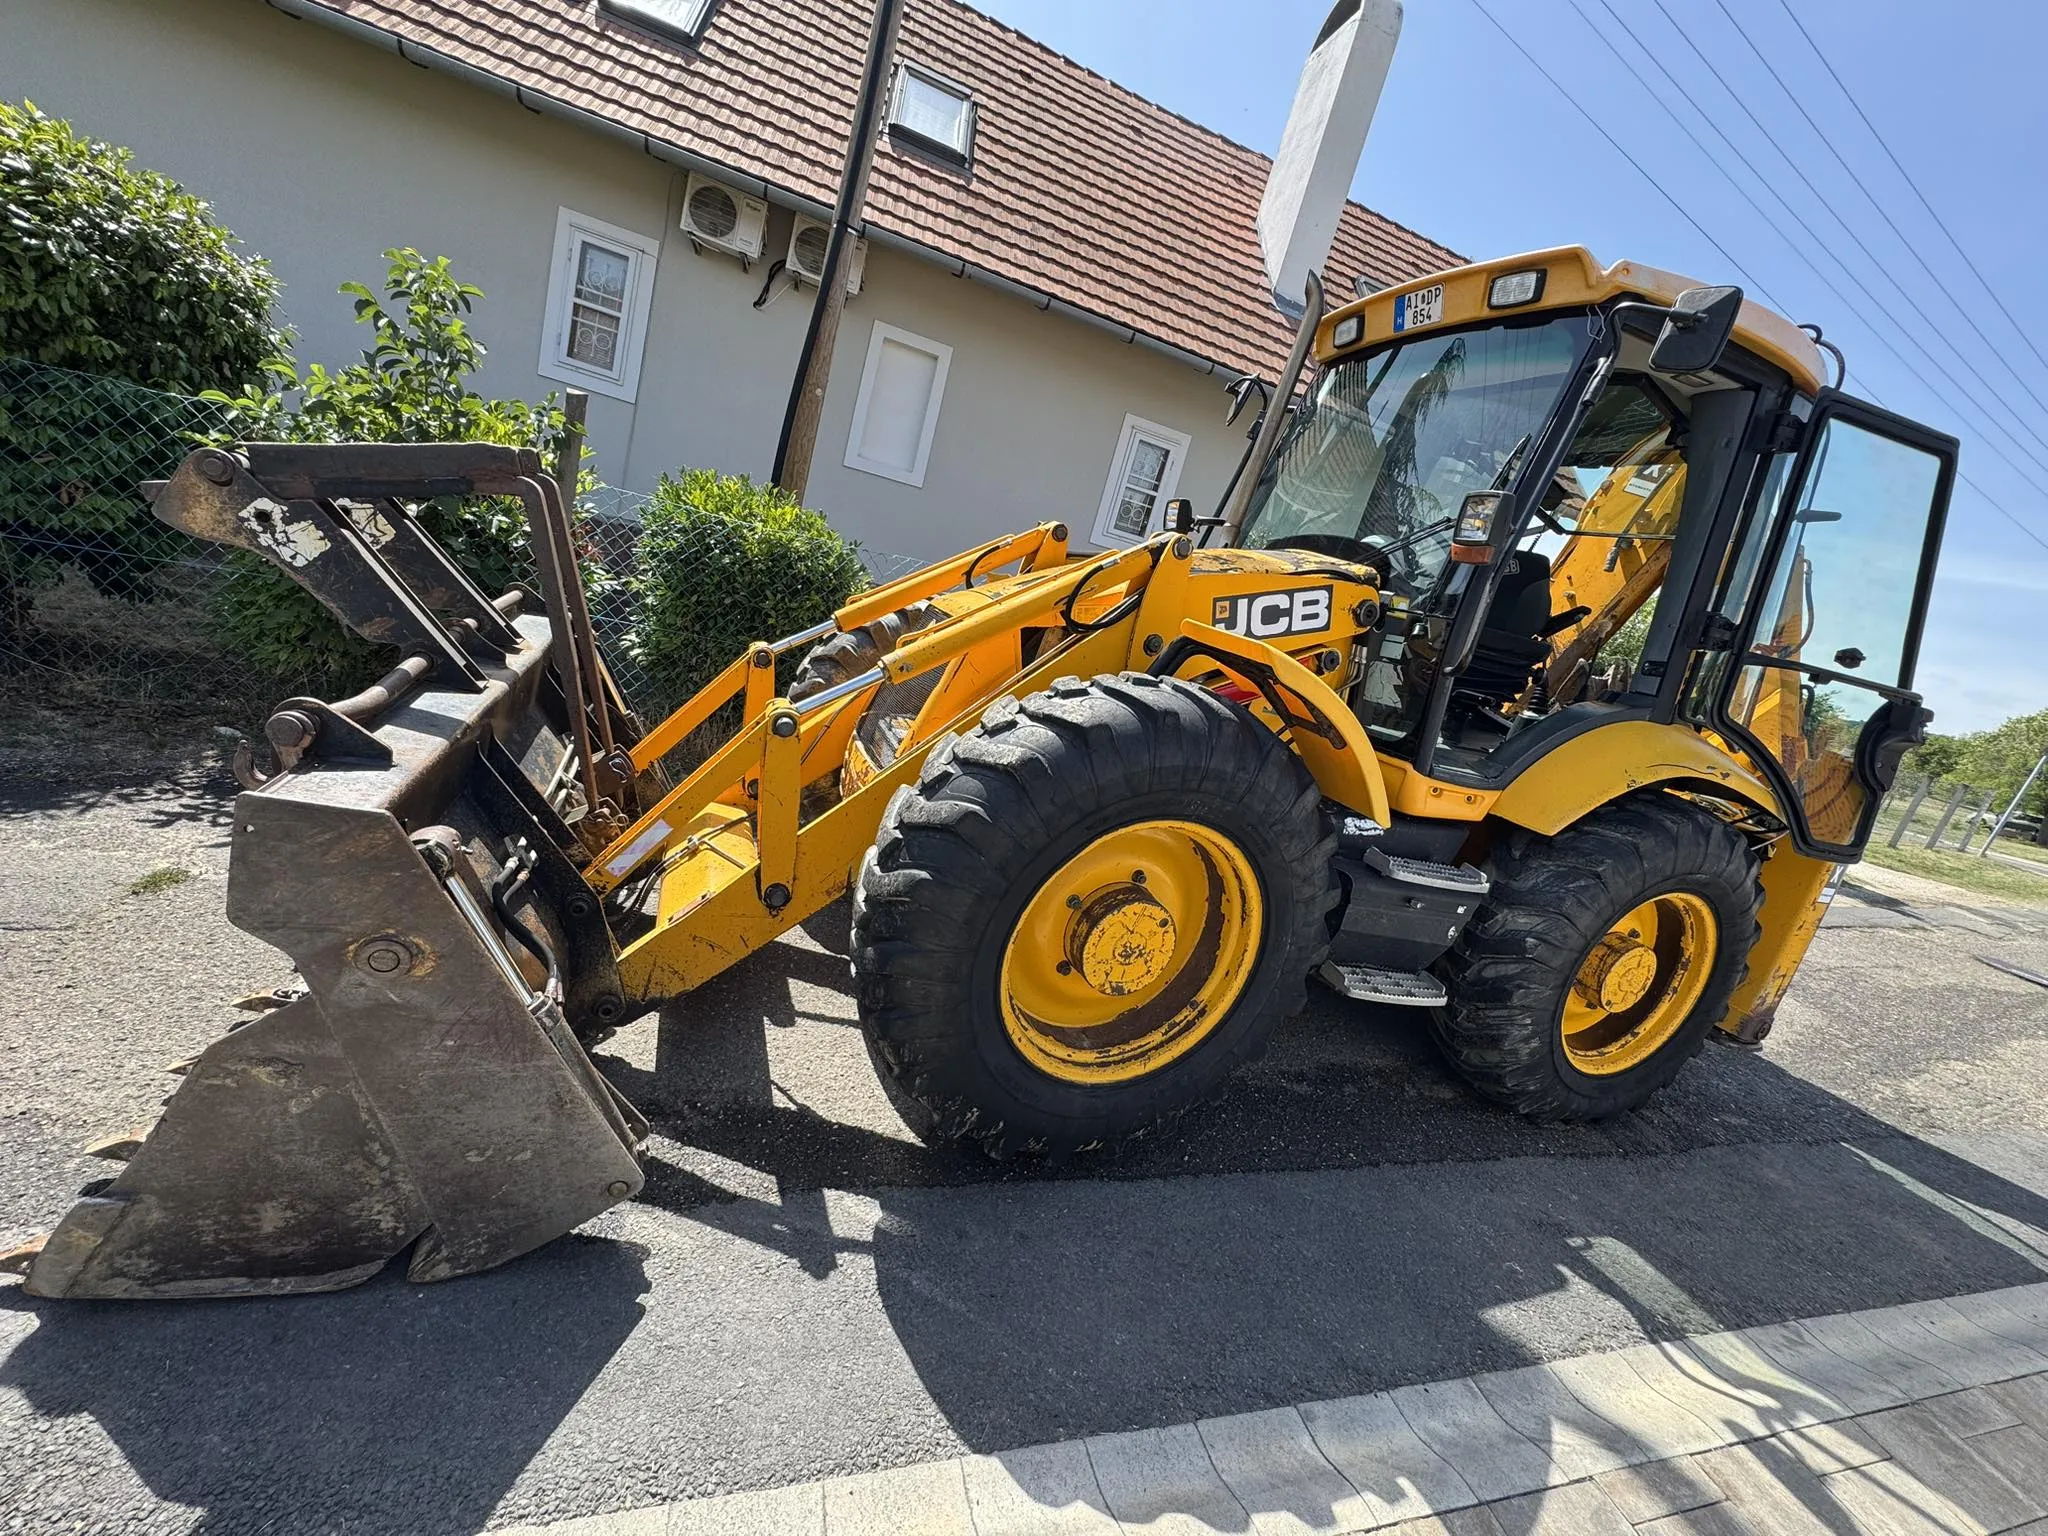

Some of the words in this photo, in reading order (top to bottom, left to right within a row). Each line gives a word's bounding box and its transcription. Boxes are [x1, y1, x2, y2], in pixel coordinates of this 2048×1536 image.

[1397, 317, 1403, 325] H
[1412, 307, 1432, 325] 854
[1214, 589, 1329, 637] JCB
